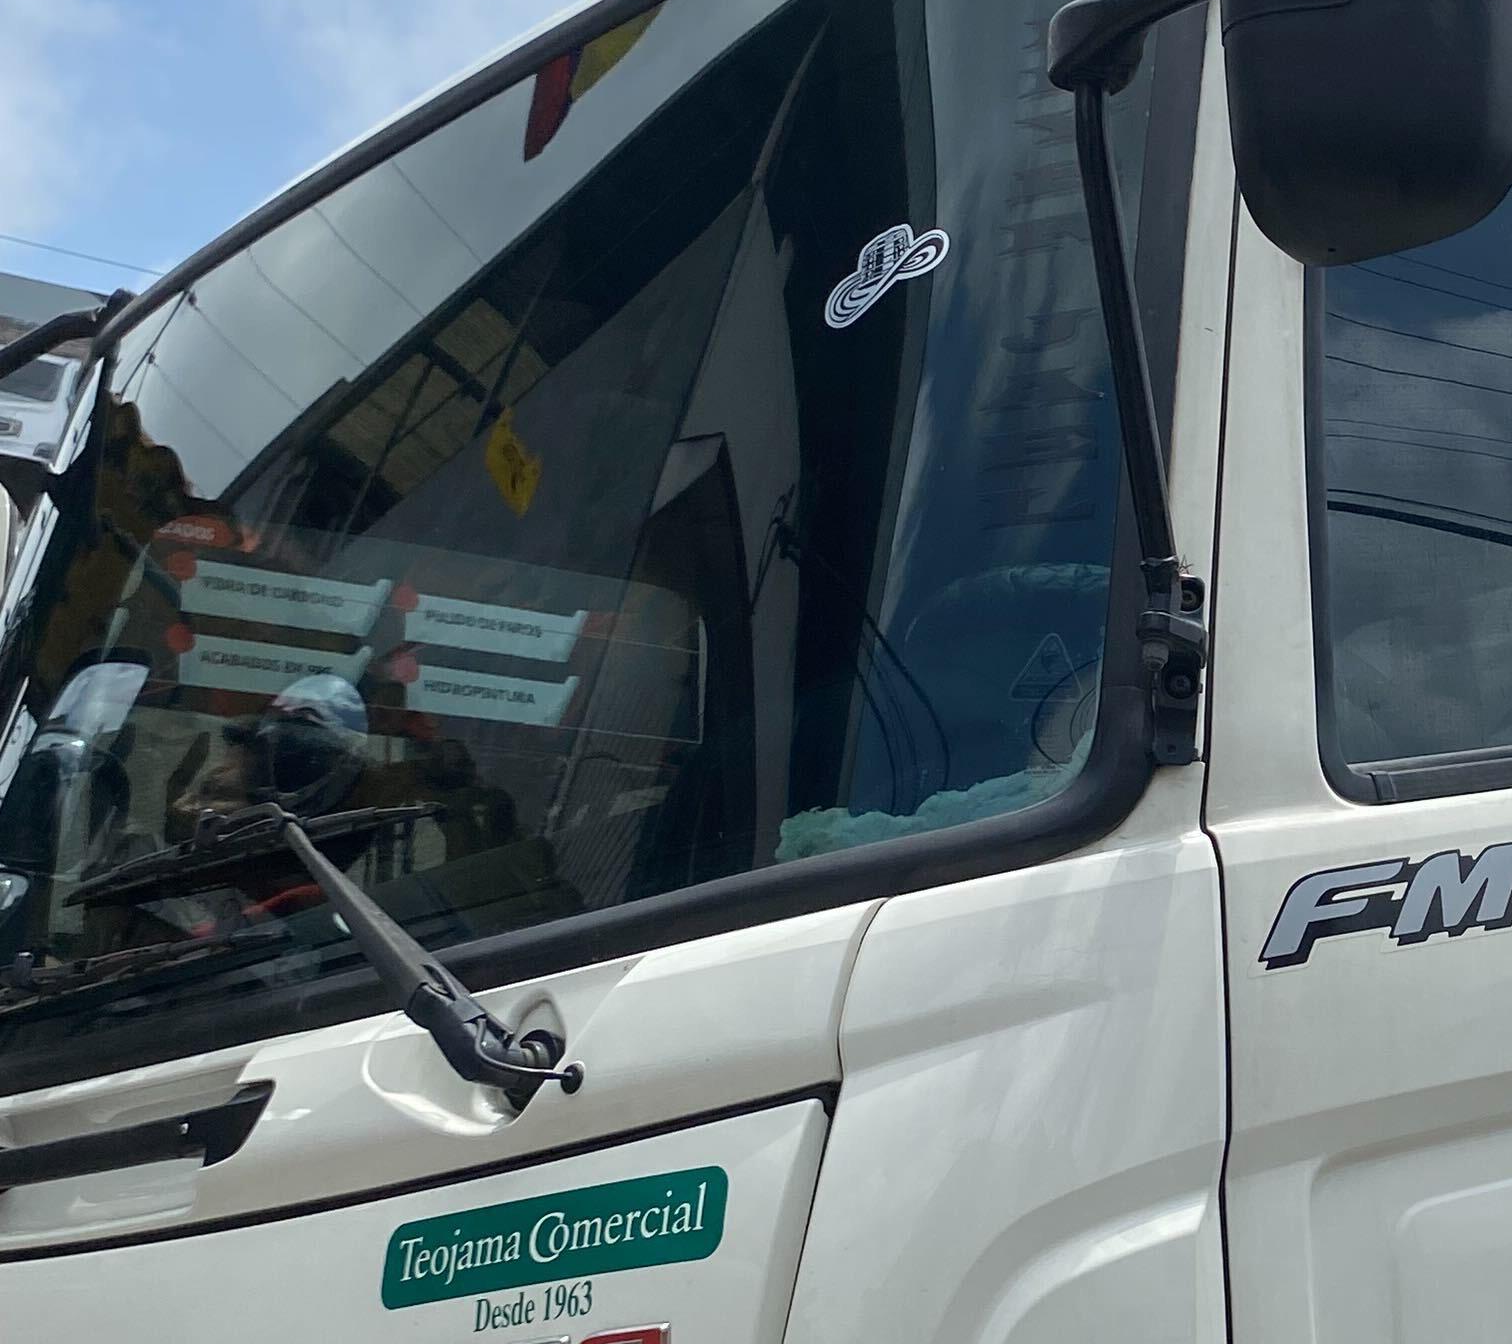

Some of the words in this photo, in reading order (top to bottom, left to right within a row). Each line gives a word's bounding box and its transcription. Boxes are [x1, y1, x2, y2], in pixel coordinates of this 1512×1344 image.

[400, 1228, 521, 1285] Teojama
[528, 1182, 708, 1264] Comercial
[473, 1291, 535, 1332] Desde
[543, 1280, 593, 1322] 1963
